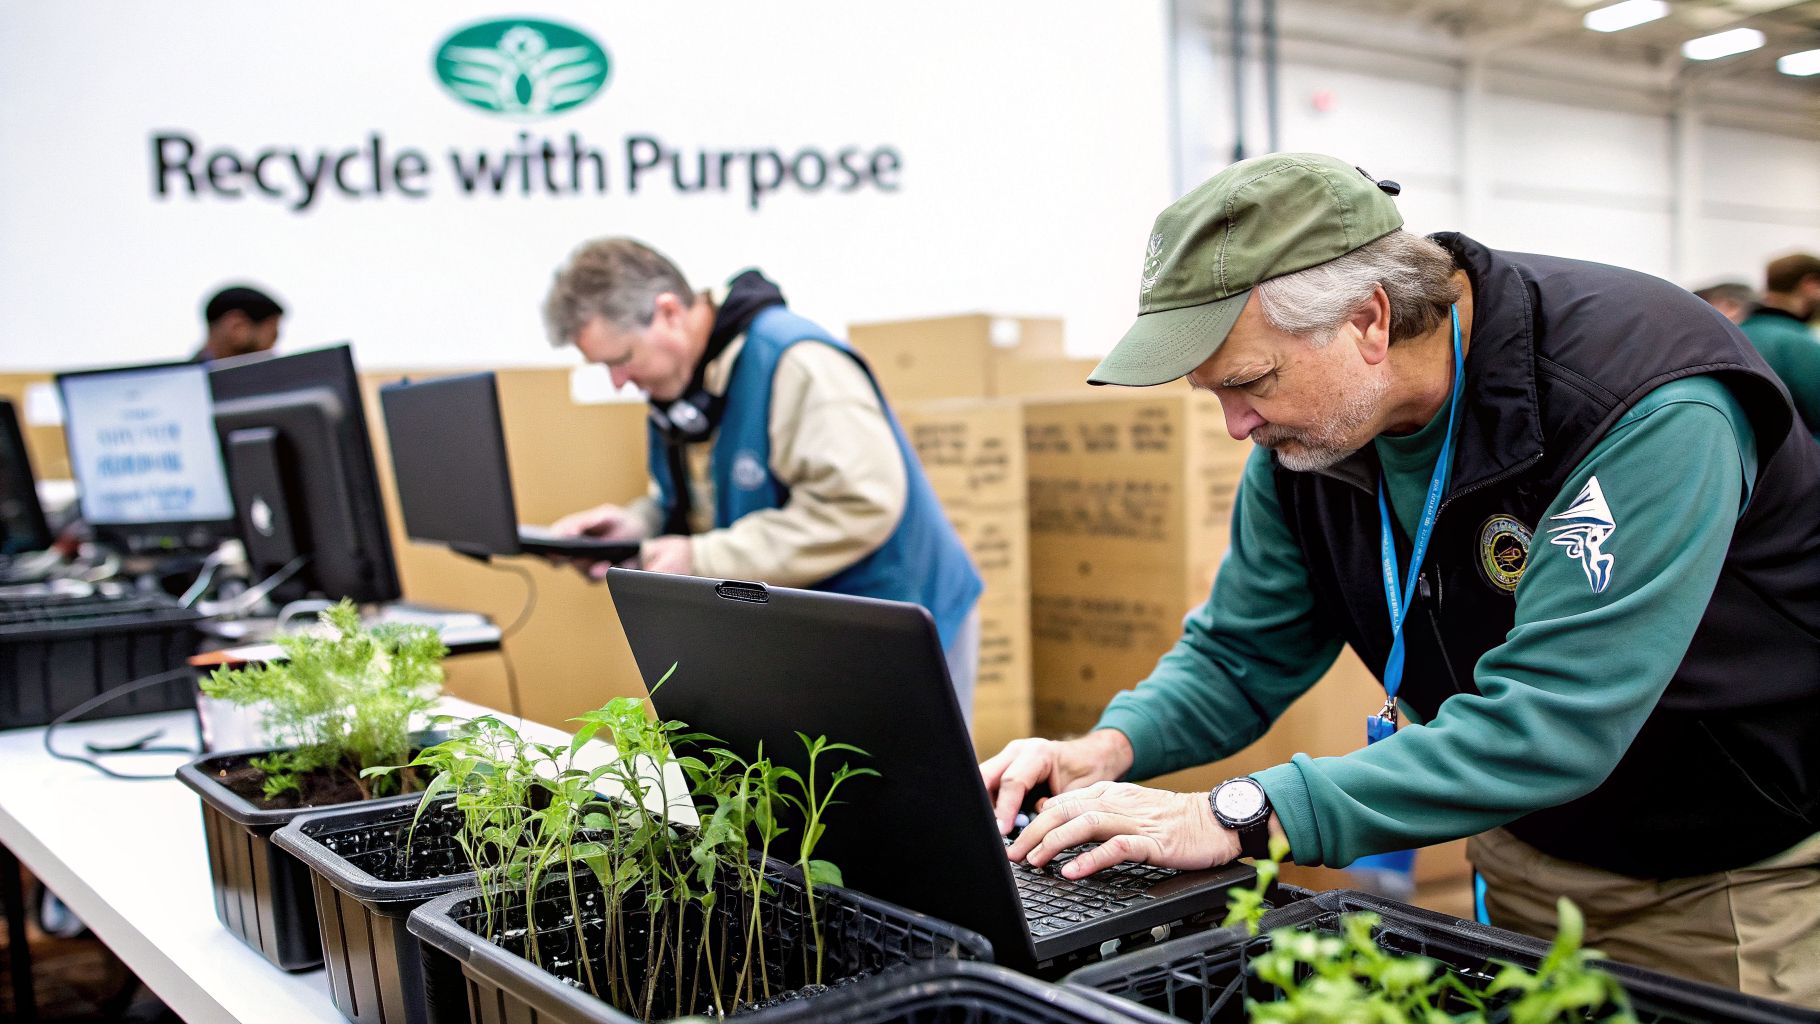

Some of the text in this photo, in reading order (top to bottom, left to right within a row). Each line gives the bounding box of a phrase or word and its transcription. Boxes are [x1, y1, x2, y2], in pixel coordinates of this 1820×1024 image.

[151, 131, 901, 211] Recycle with Purpose
